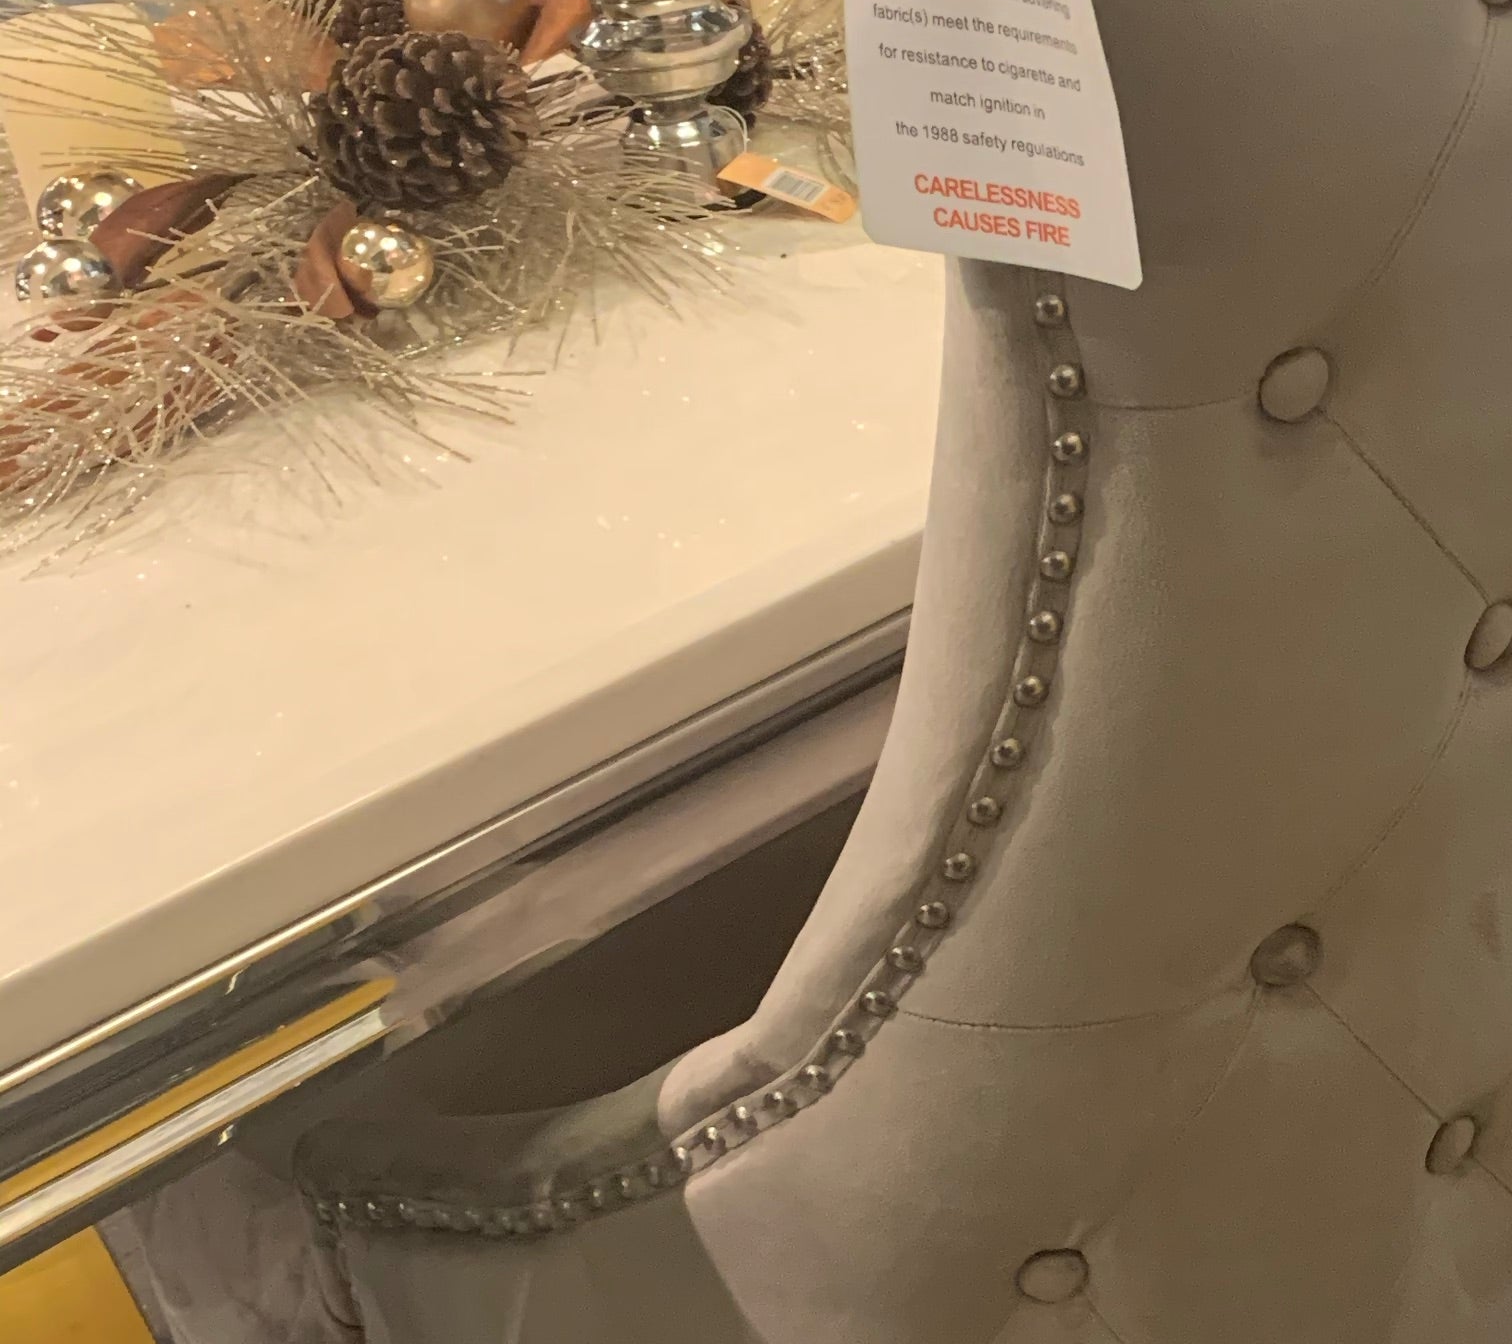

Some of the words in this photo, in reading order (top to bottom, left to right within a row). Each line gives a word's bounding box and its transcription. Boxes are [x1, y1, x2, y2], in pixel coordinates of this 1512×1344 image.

[873, 3, 928, 26] fabric(s)
[932, 15, 969, 31] meet
[972, 17, 994, 34] the
[998, 23, 1078, 55] requirements
[878, 42, 897, 59] for
[901, 49, 978, 70] resistance
[981, 57, 995, 72] to
[998, 60, 1056, 85] cigarette
[1058, 75, 1081, 92] and
[930, 90, 976, 108] match
[980, 95, 1031, 115] ignition
[1033, 106, 1046, 120] in
[895, 121, 918, 138] the
[922, 125, 958, 143] 1988
[962, 131, 1007, 152] safety
[1011, 139, 1085, 166] regulations
[914, 173, 1081, 218] CARELESSNESS
[933, 207, 1021, 238] CAUSES
[1026, 221, 1072, 247] FIRE
